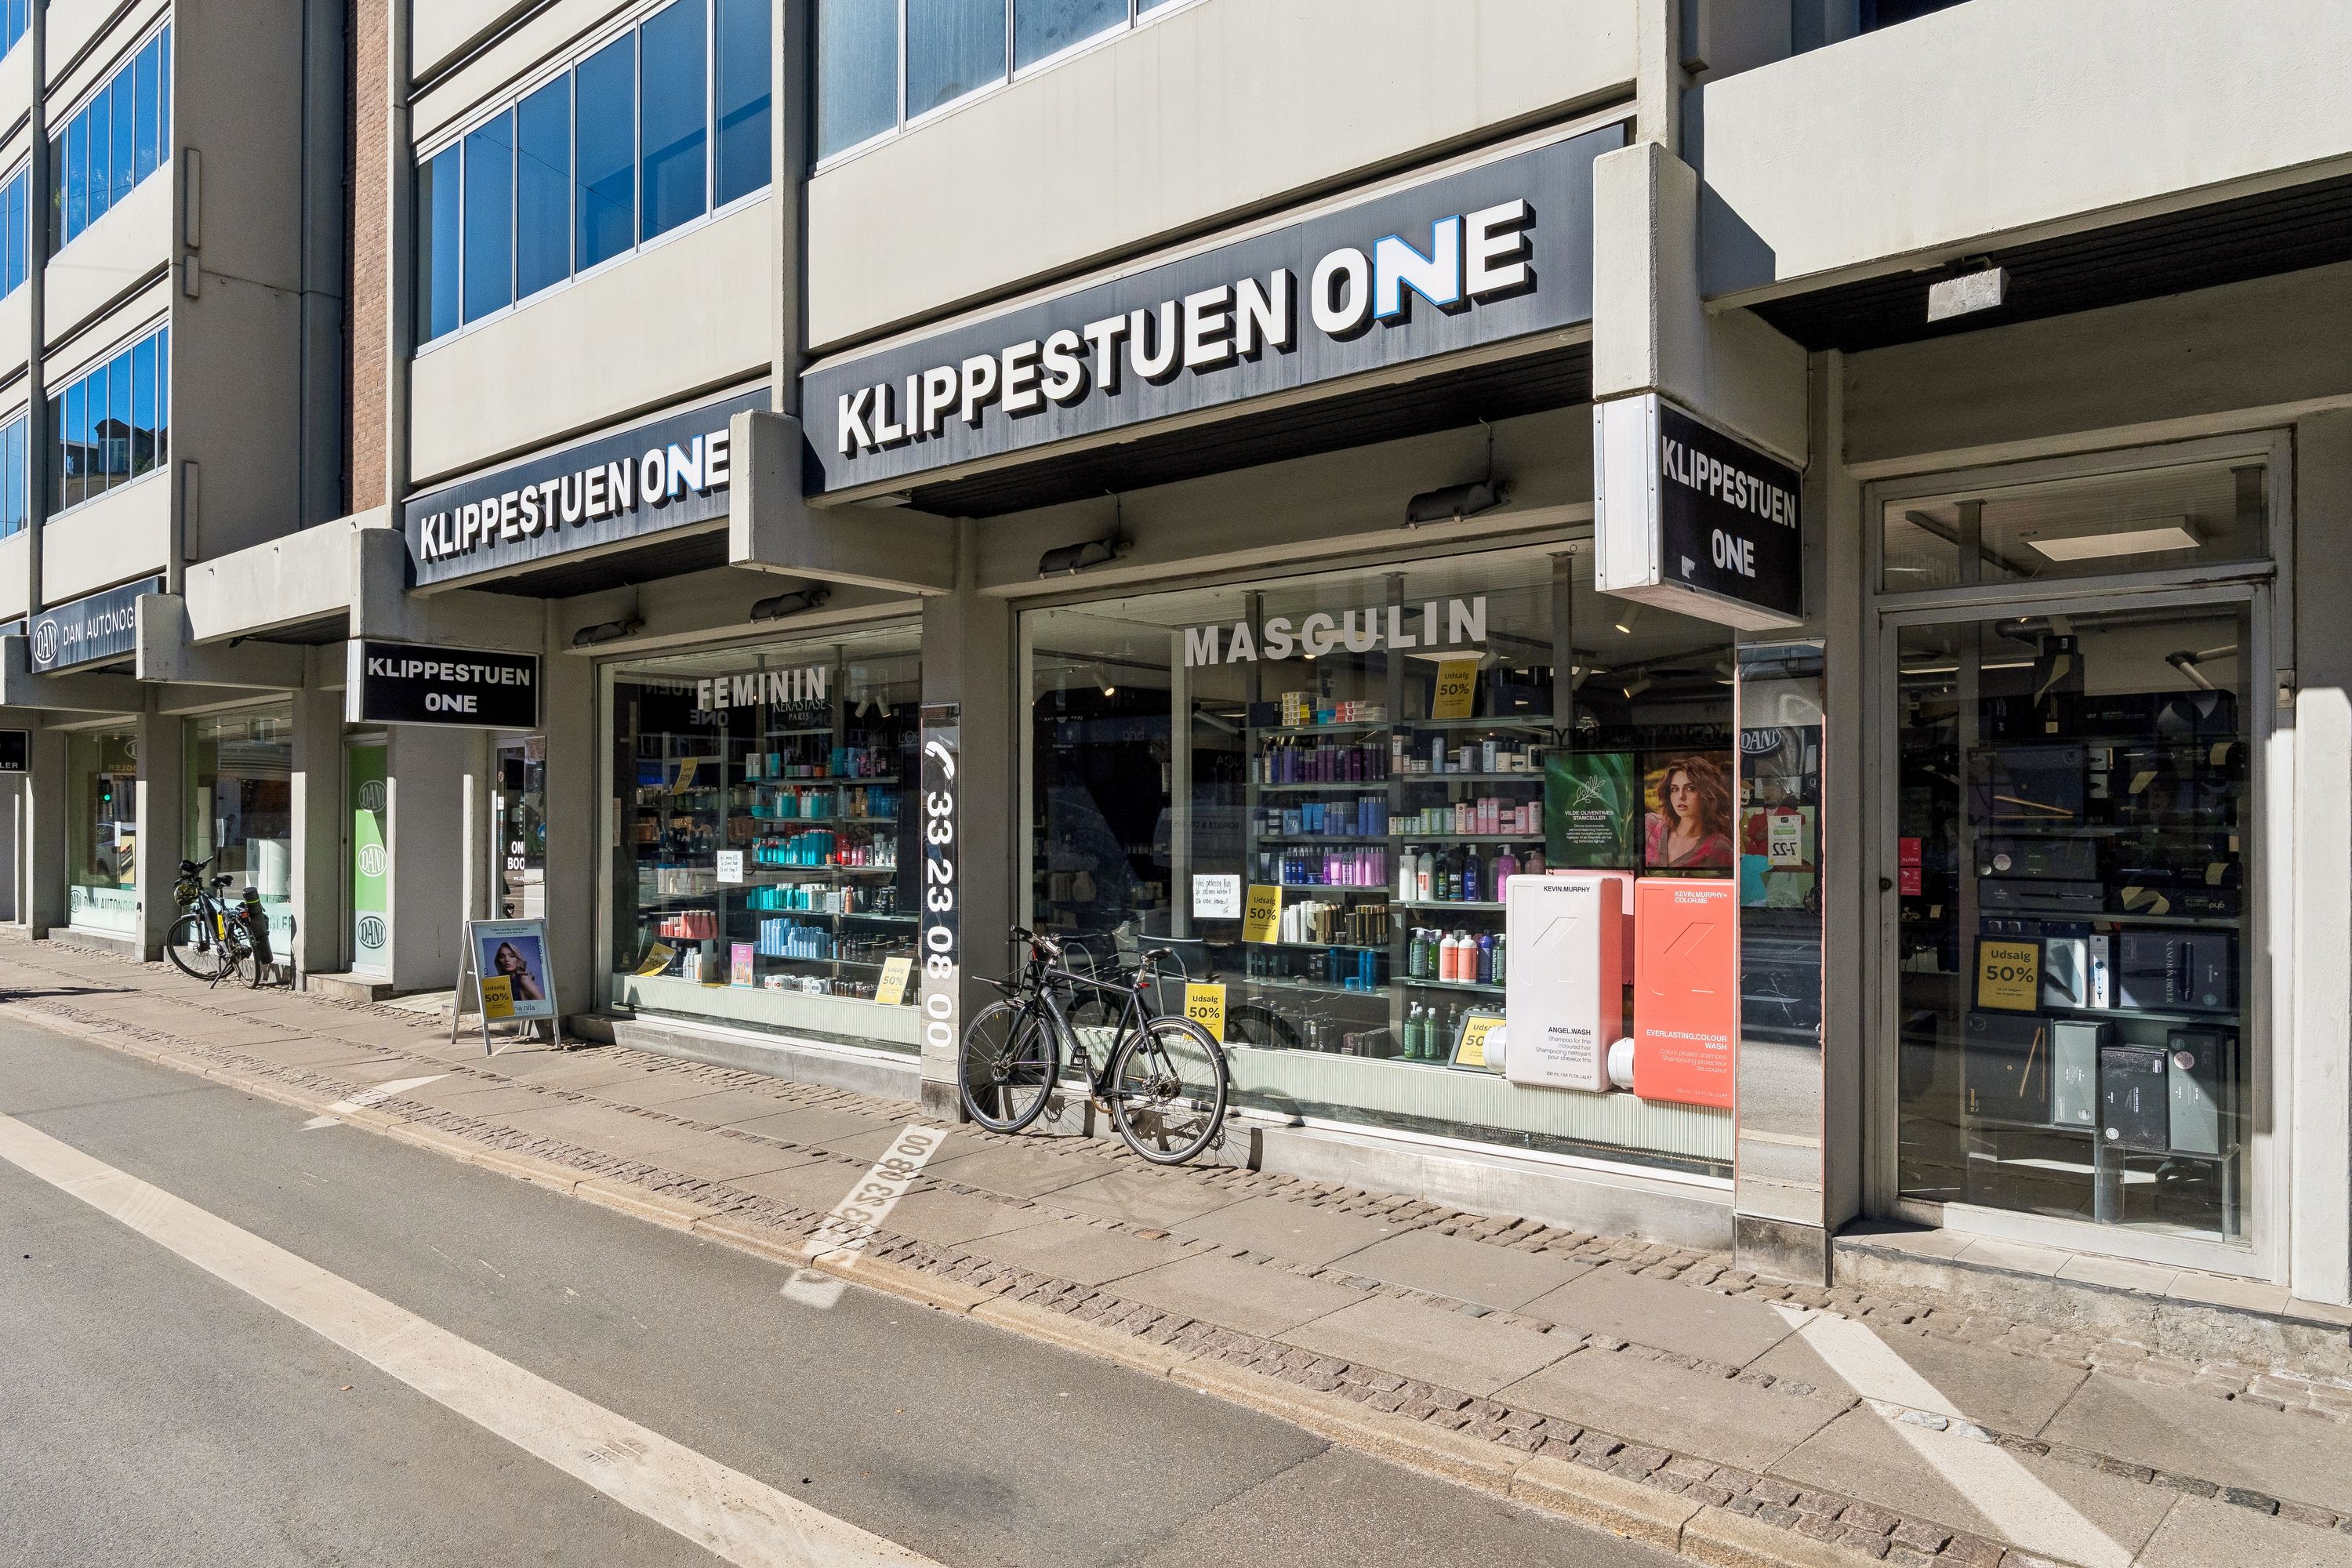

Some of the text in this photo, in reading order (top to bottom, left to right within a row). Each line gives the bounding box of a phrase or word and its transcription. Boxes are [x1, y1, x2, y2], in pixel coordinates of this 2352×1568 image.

[838, 198, 1529, 456] KLIPPESTUEN ONE
[1662, 435, 1795, 529] KLIPPESTUEN
[420, 428, 729, 561] KLIPPESTUEN ONE
[1711, 528, 1755, 579] ONE
[64, 621, 84, 646] DANI
[1184, 596, 1486, 667] MASCULIN
[36, 625, 57, 659] DANI
[368, 657, 531, 686] KLIPPESTUEN
[1445, 670, 1469, 681] Udsalg
[697, 666, 826, 710] FEMININ
[1439, 683, 1470, 696] 50%
[425, 692, 478, 713] ONE
[789, 712, 810, 720] PARIS
[361, 786, 386, 808] DANI
[511, 840, 524, 855] ON
[361, 849, 386, 872] DANI
[1254, 896, 1276, 906] Udsalg
[927, 792, 953, 1048] 33 23 08 00
[1249, 908, 1276, 920] 50%
[361, 921, 385, 944] DANI
[1991, 949, 2031, 963] Udsalg
[883, 975, 904, 986] 50%
[1986, 965, 2034, 982] 50%
[485, 993, 509, 1002] 50%
[1192, 995, 1218, 1004] Udsalg
[1189, 1007, 1220, 1018] 50%
[1548, 1026, 1592, 1035] ANGEL.WASH
[1646, 1029, 1726, 1042] EVERLASTING.COLOUR
[1465, 1034, 1484, 1047] 50
[1536, 1047, 1567, 1056] Shampooing
